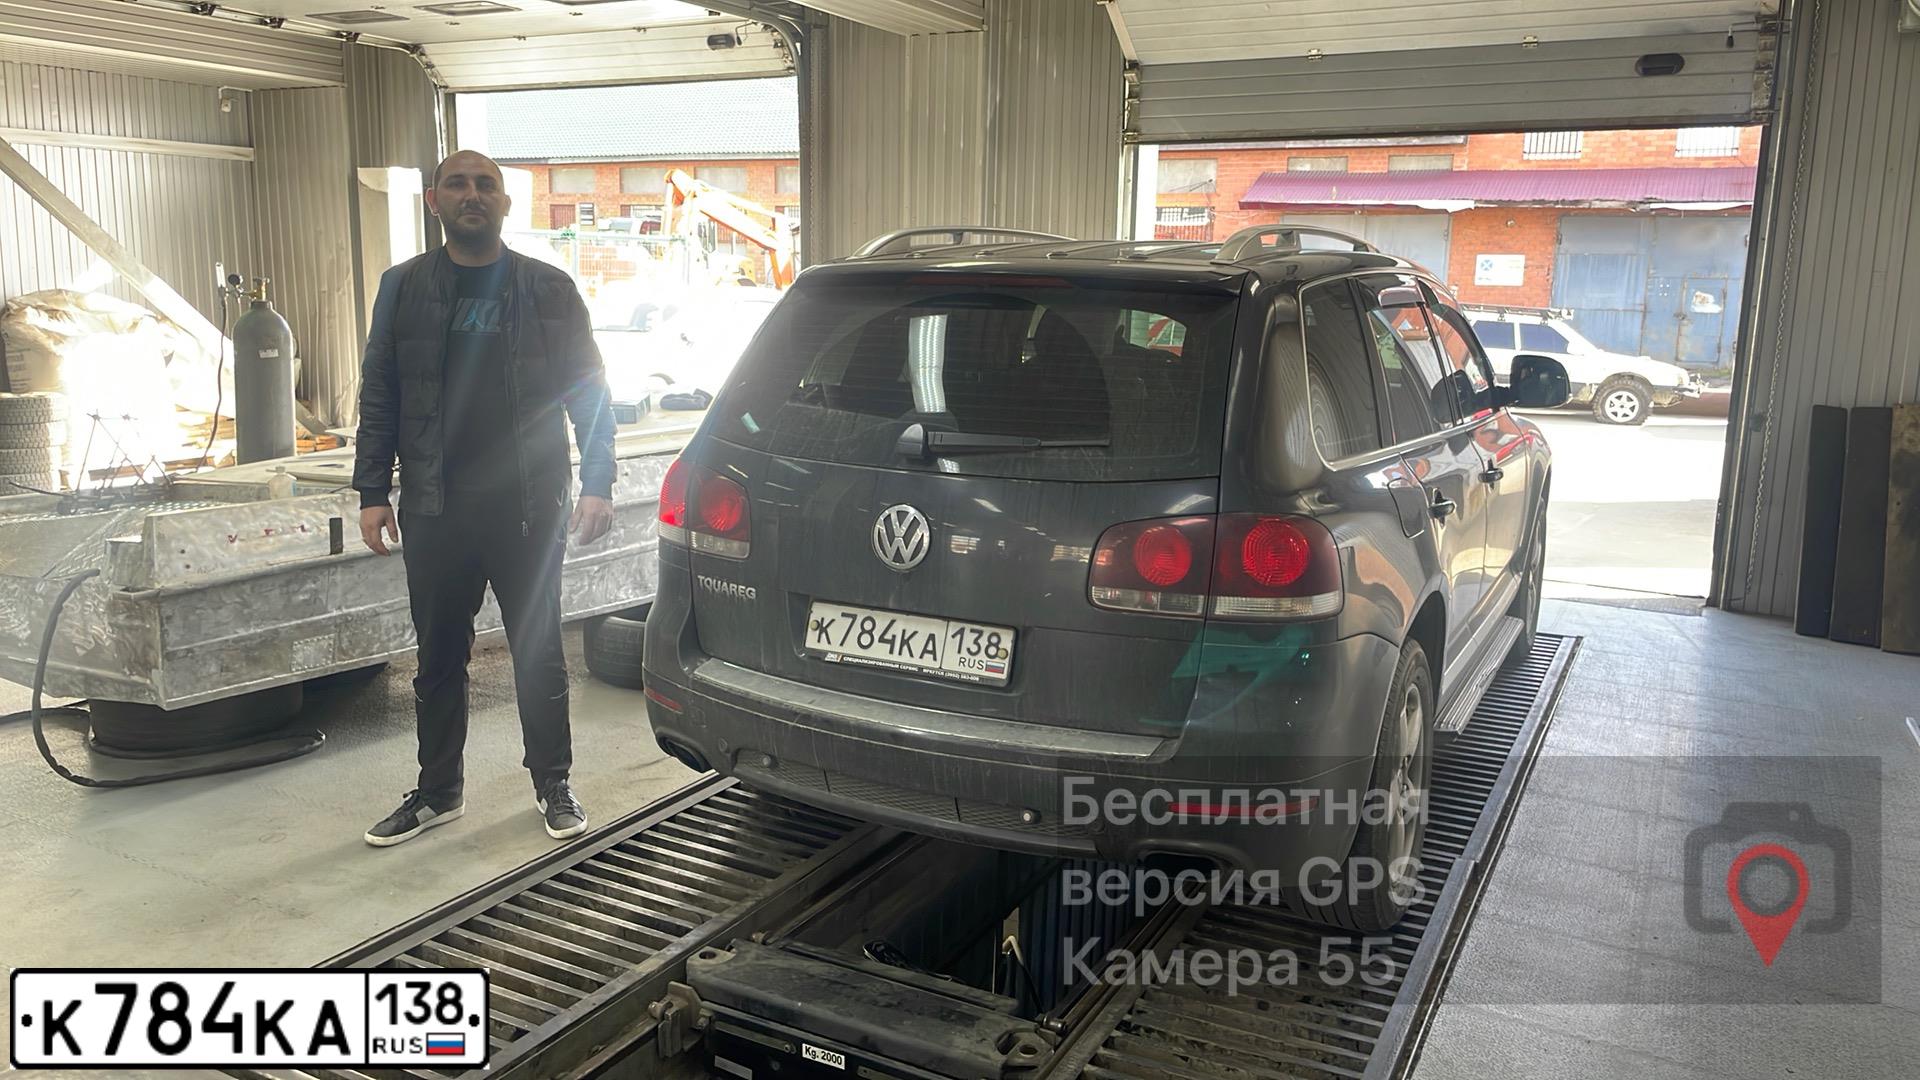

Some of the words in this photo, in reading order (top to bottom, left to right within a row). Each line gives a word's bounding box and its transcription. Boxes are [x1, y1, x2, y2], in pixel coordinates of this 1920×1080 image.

[697, 575, 757, 600] TOUAREG
[817, 611, 939, 662] К784КА
[950, 627, 1002, 660] 138
[958, 656, 985, 671] RUS
[805, 1046, 819, 1059] Kg.
[821, 1051, 842, 1065] 2000
